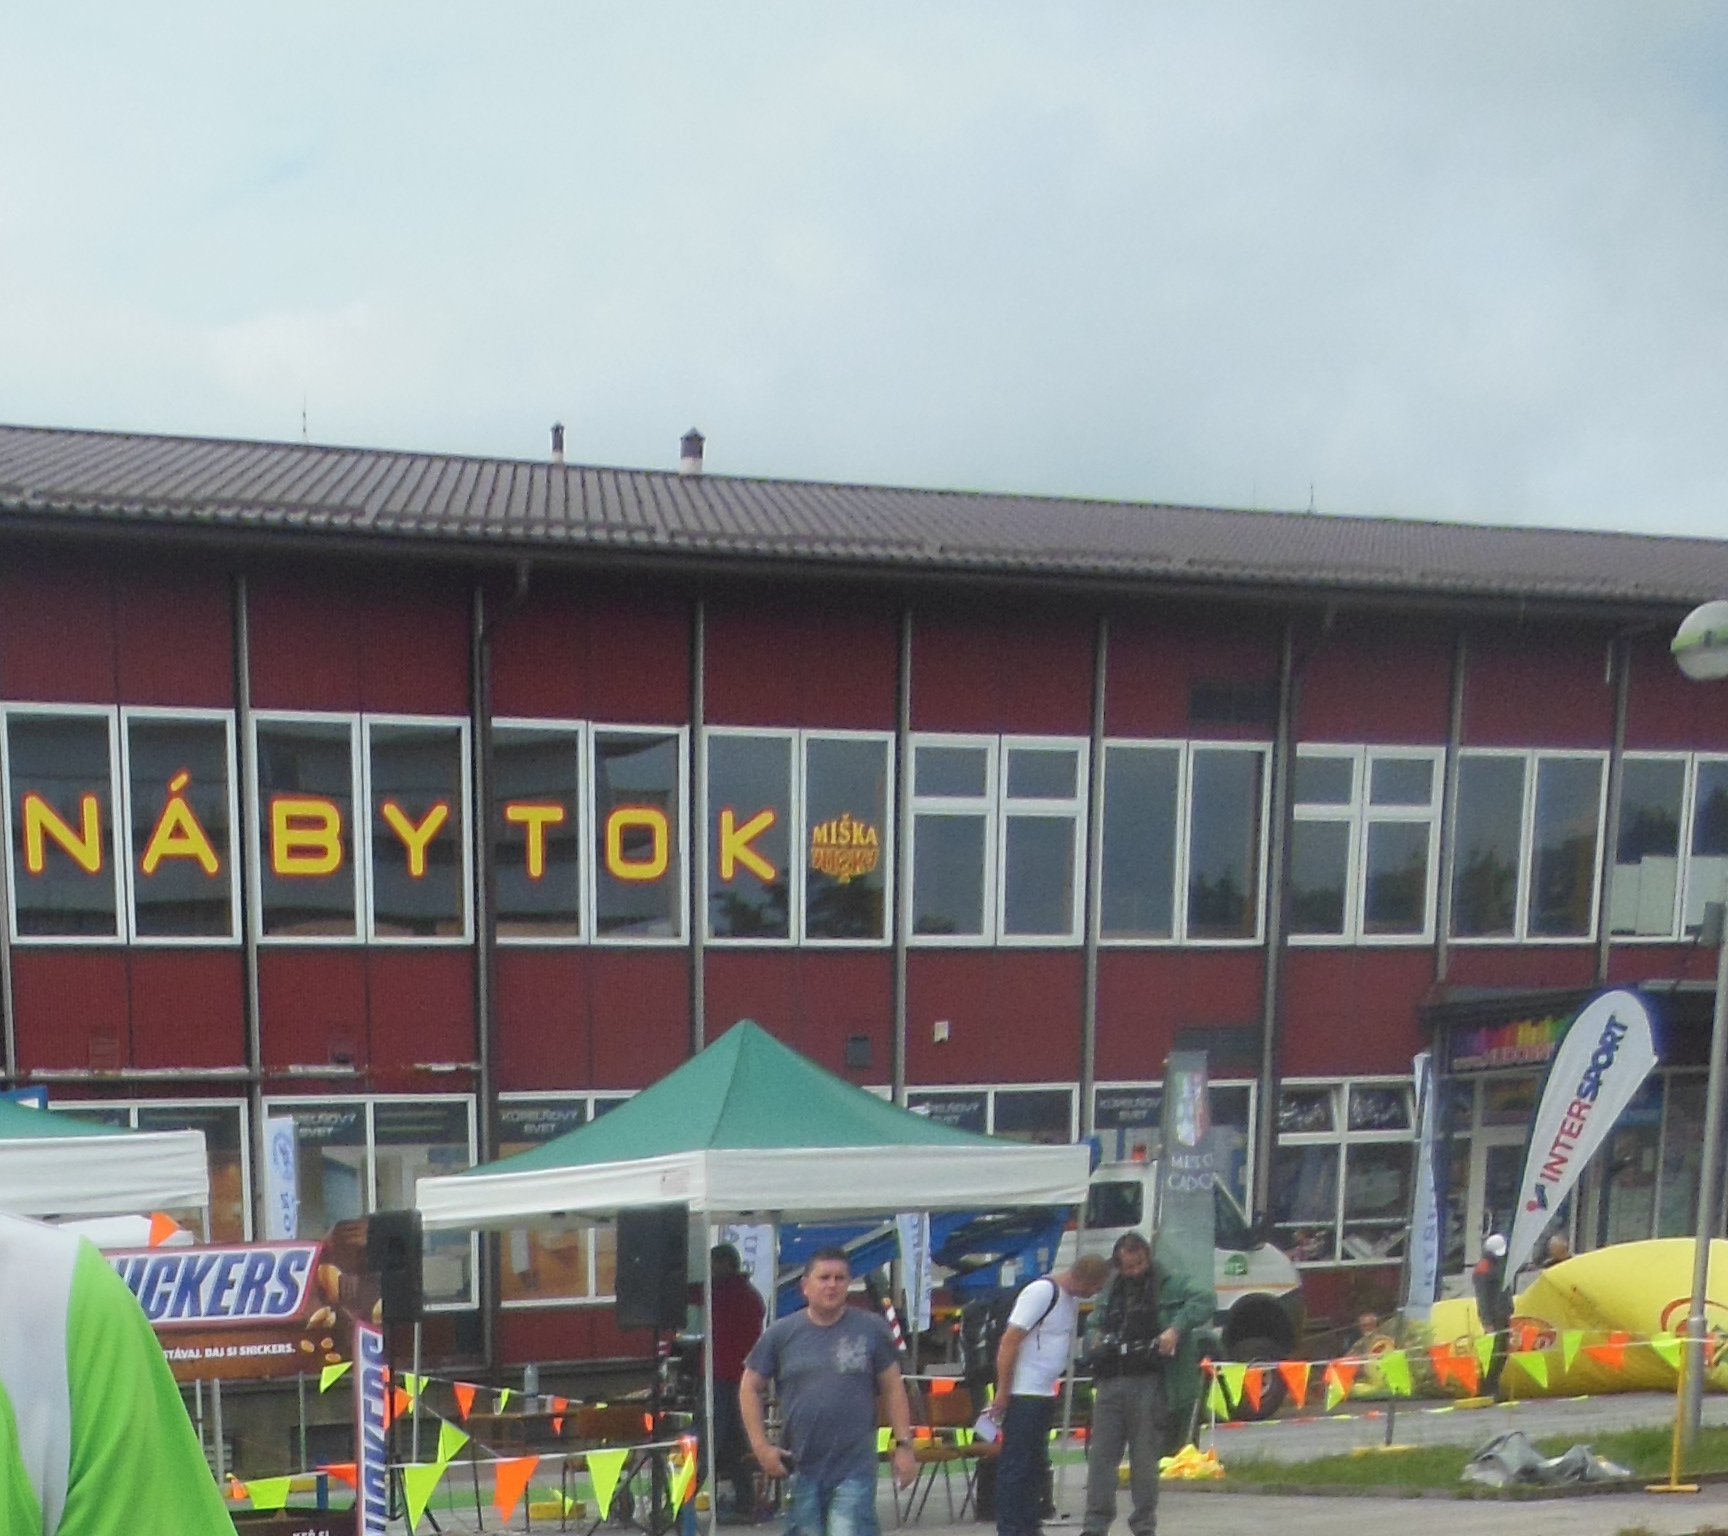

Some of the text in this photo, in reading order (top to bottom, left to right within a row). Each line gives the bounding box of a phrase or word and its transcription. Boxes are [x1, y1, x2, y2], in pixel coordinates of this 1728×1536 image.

[21, 768, 777, 884] NÁBYTOK
[813, 812, 878, 846] MIŠKA
[1538, 1013, 1630, 1184] INTERSPORT
[115, 1249, 313, 1321] ICKERS
